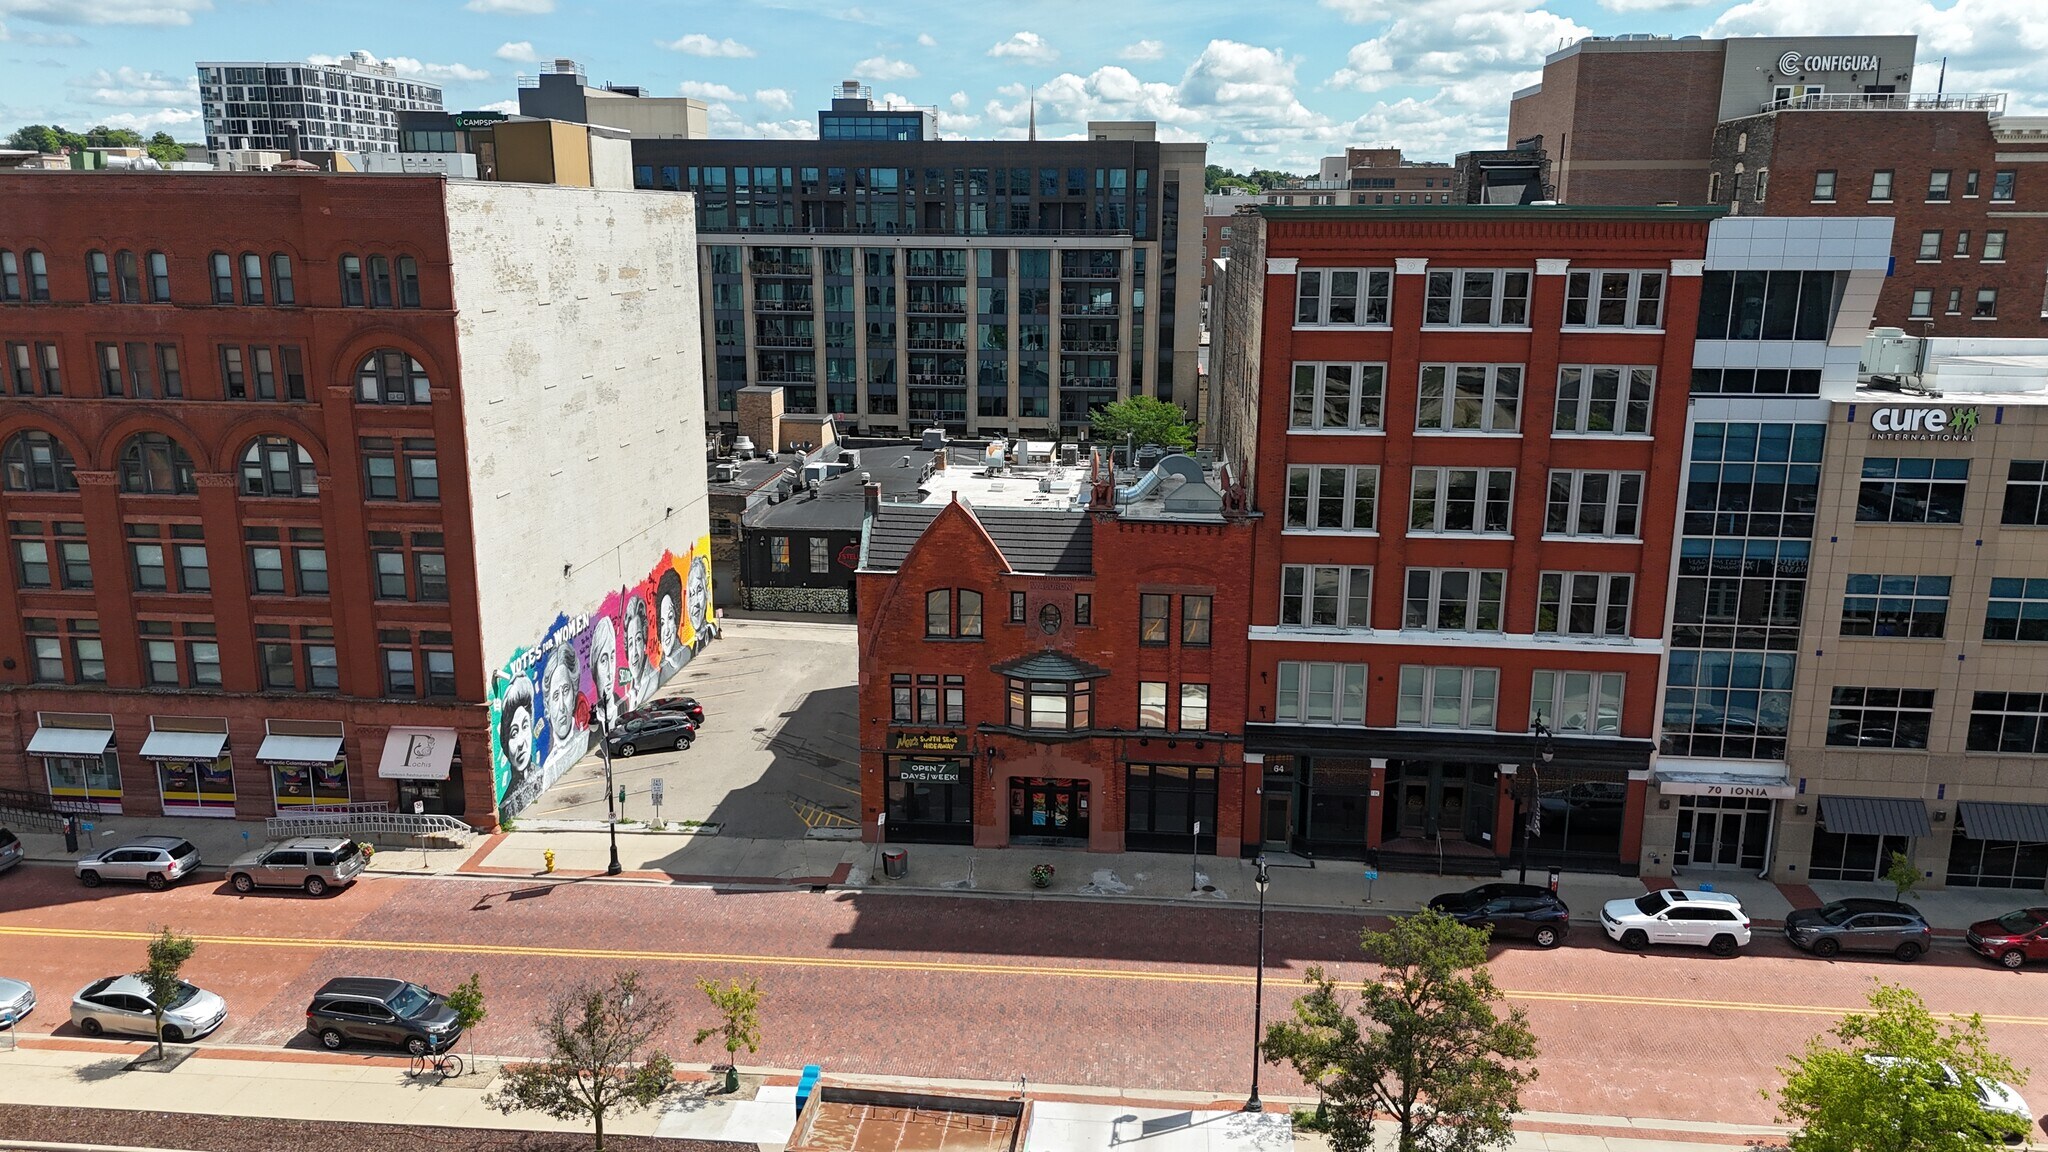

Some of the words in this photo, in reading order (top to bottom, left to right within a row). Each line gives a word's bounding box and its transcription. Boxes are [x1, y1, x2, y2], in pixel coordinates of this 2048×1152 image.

[1804, 55, 1878, 72] CONFIGURA
[1871, 408, 1948, 432] cure
[1871, 433, 1976, 442] INTERNATIONAL
[1030, 582, 1073, 590] WALDRON
[510, 645, 543, 675] VOTES
[553, 611, 590, 647] WOMEN
[911, 764, 937, 772] OPEN
[937, 764, 947, 773] 7
[1273, 765, 1284, 773] 64
[1707, 786, 1722, 794] 70
[1730, 787, 1768, 796] IONIA
